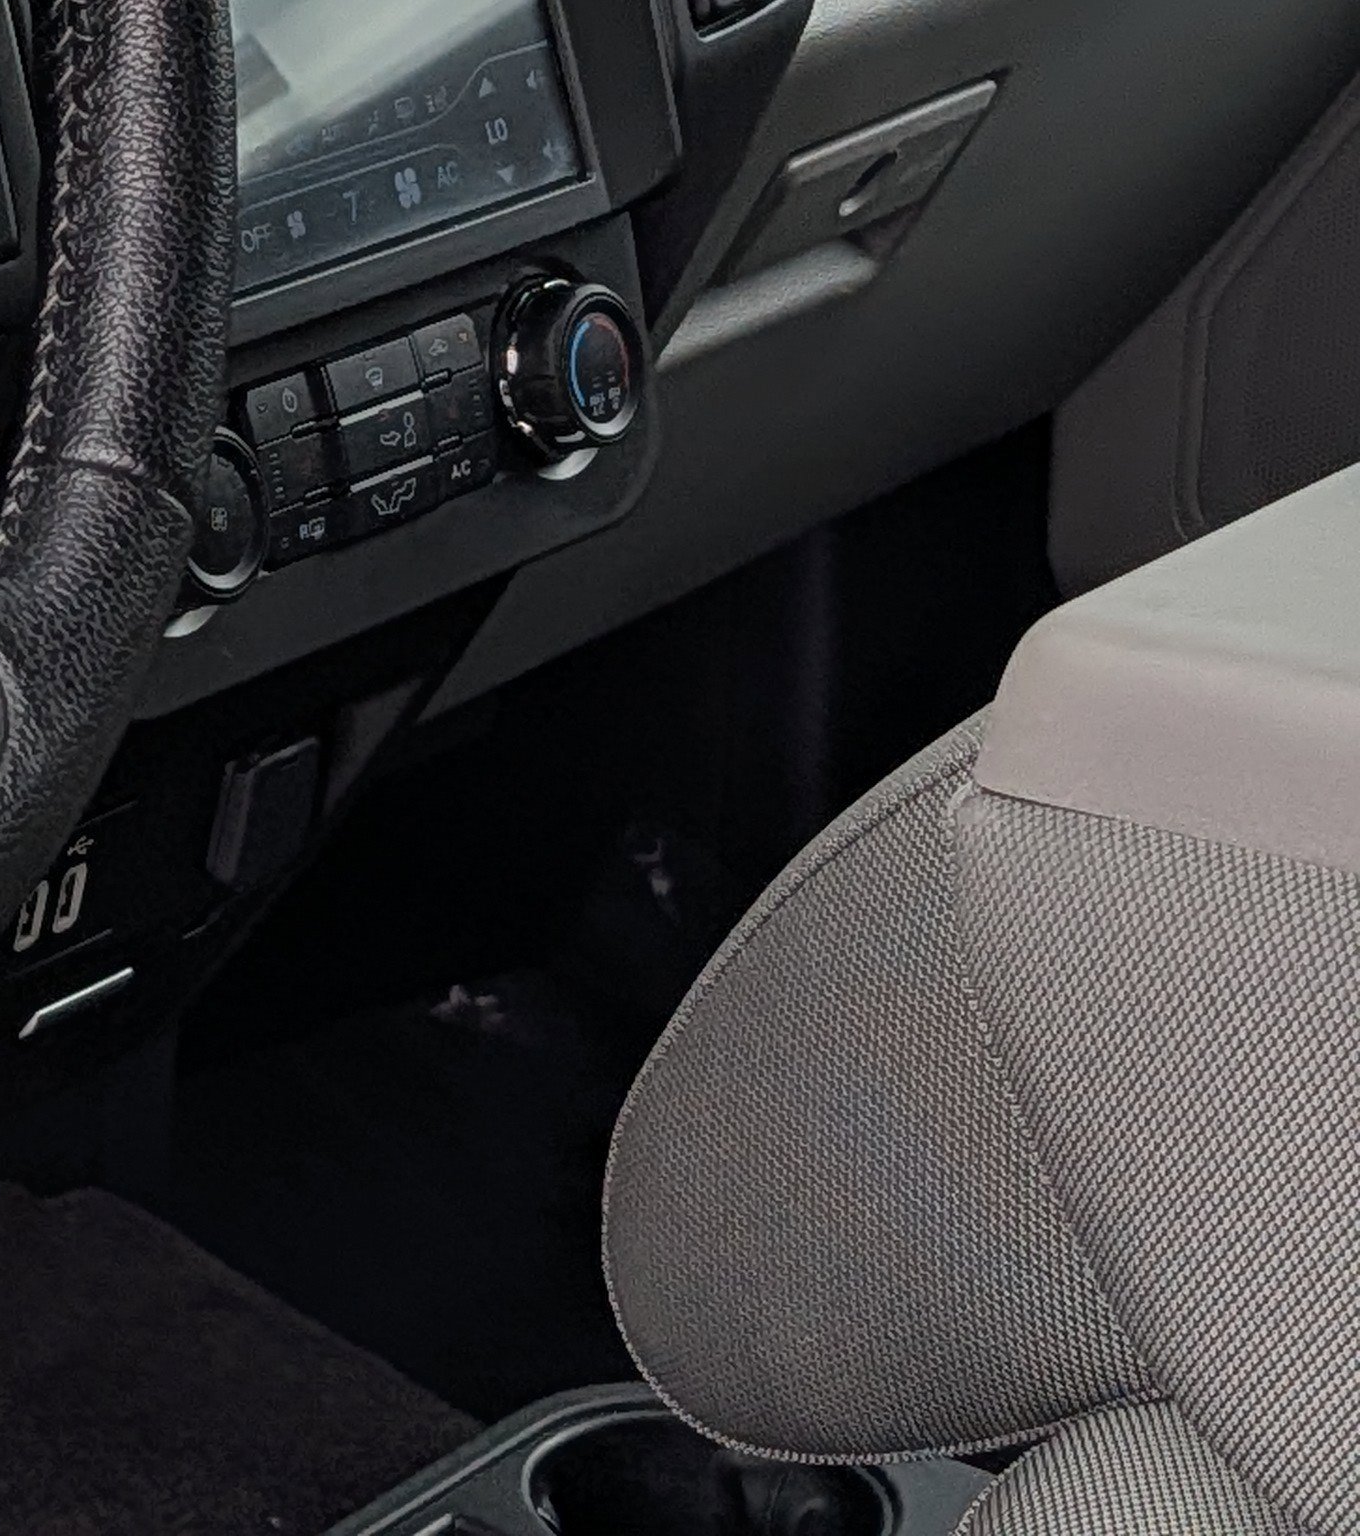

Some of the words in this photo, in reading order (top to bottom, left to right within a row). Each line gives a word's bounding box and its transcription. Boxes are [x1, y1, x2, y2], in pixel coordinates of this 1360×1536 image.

[485, 117, 509, 146] LO
[437, 162, 459, 189] AC
[240, 221, 273, 254] OFF
[450, 459, 472, 480] AC
